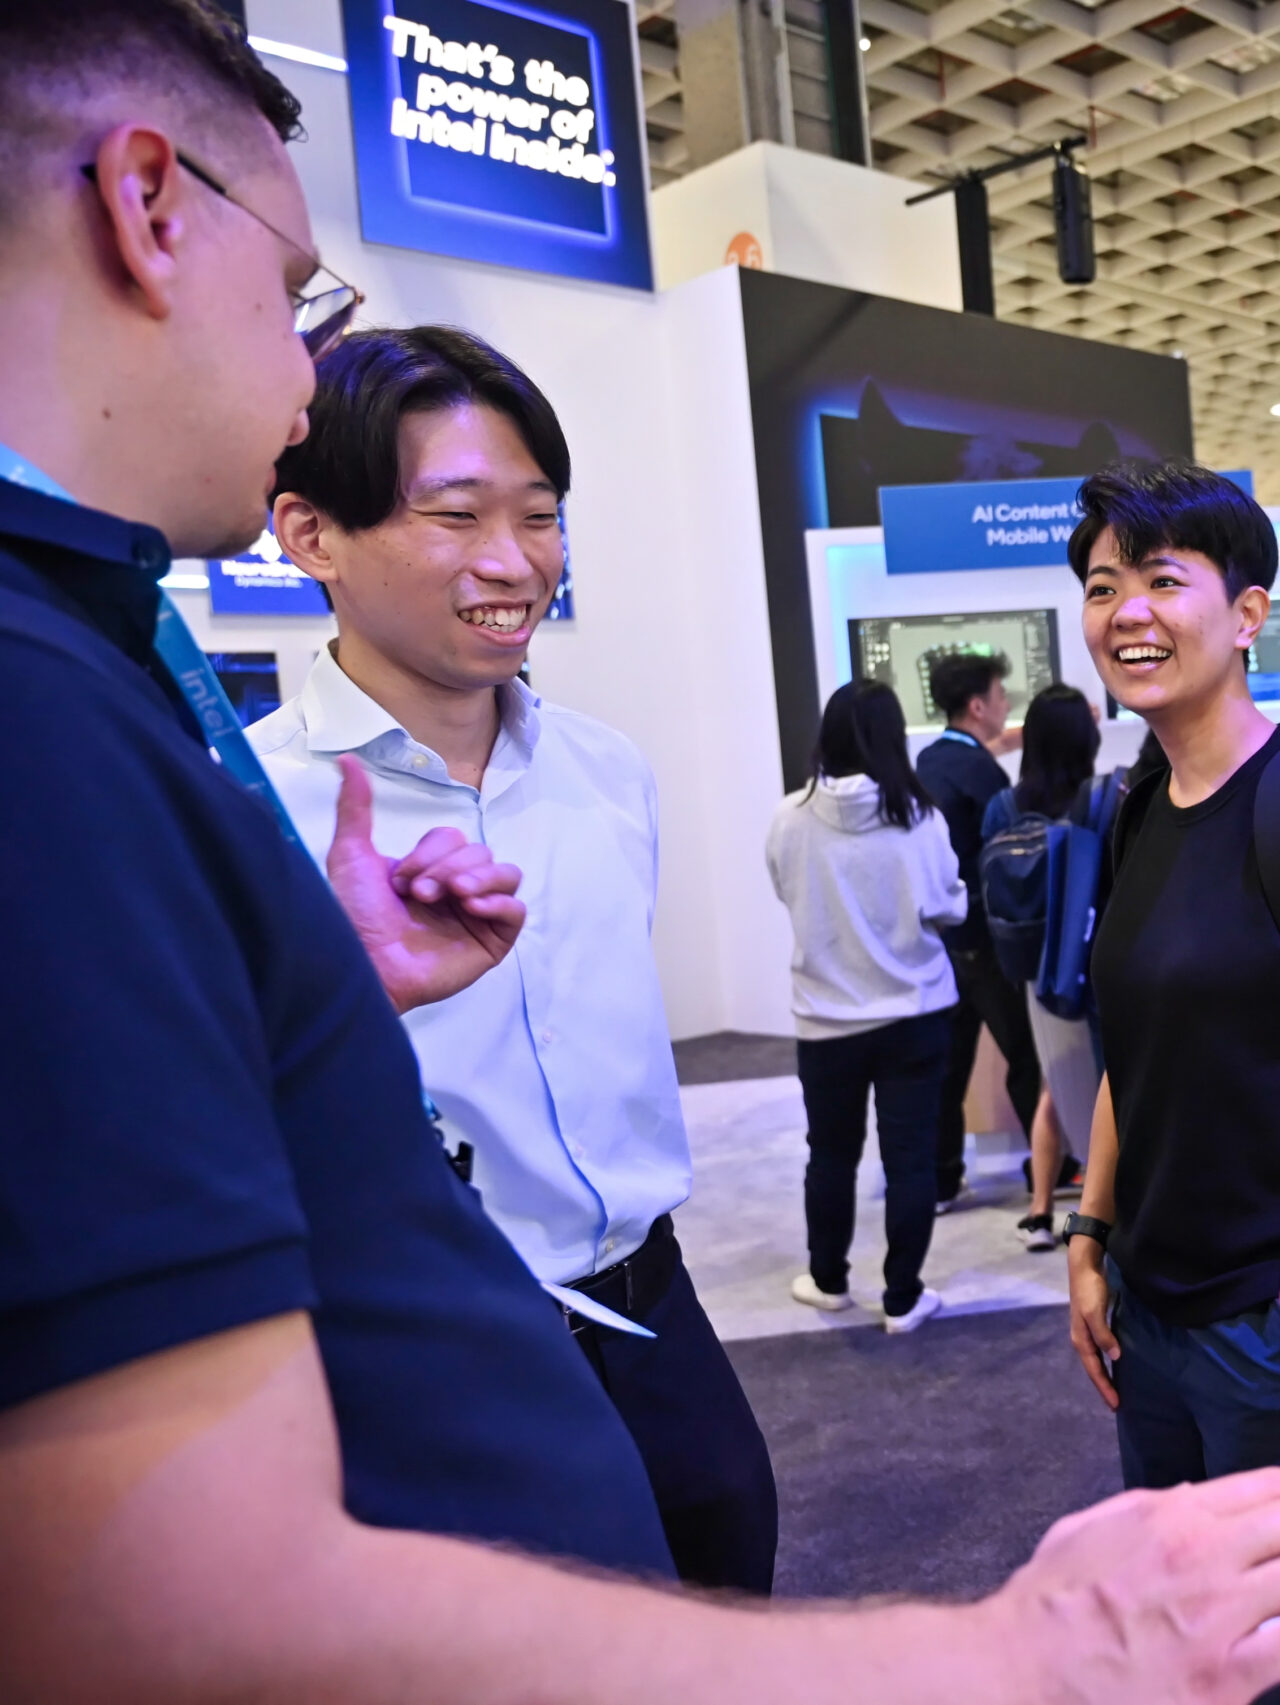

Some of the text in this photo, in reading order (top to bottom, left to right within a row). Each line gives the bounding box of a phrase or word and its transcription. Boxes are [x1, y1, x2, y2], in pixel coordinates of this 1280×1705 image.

[383, 14, 589, 106] That's the
[391, 97, 487, 155] Intel
[416, 73, 594, 143] power of
[972, 504, 993, 523] AI
[995, 503, 1069, 521] Content
[986, 527, 1049, 546] Mobile
[180, 667, 236, 738] intel
